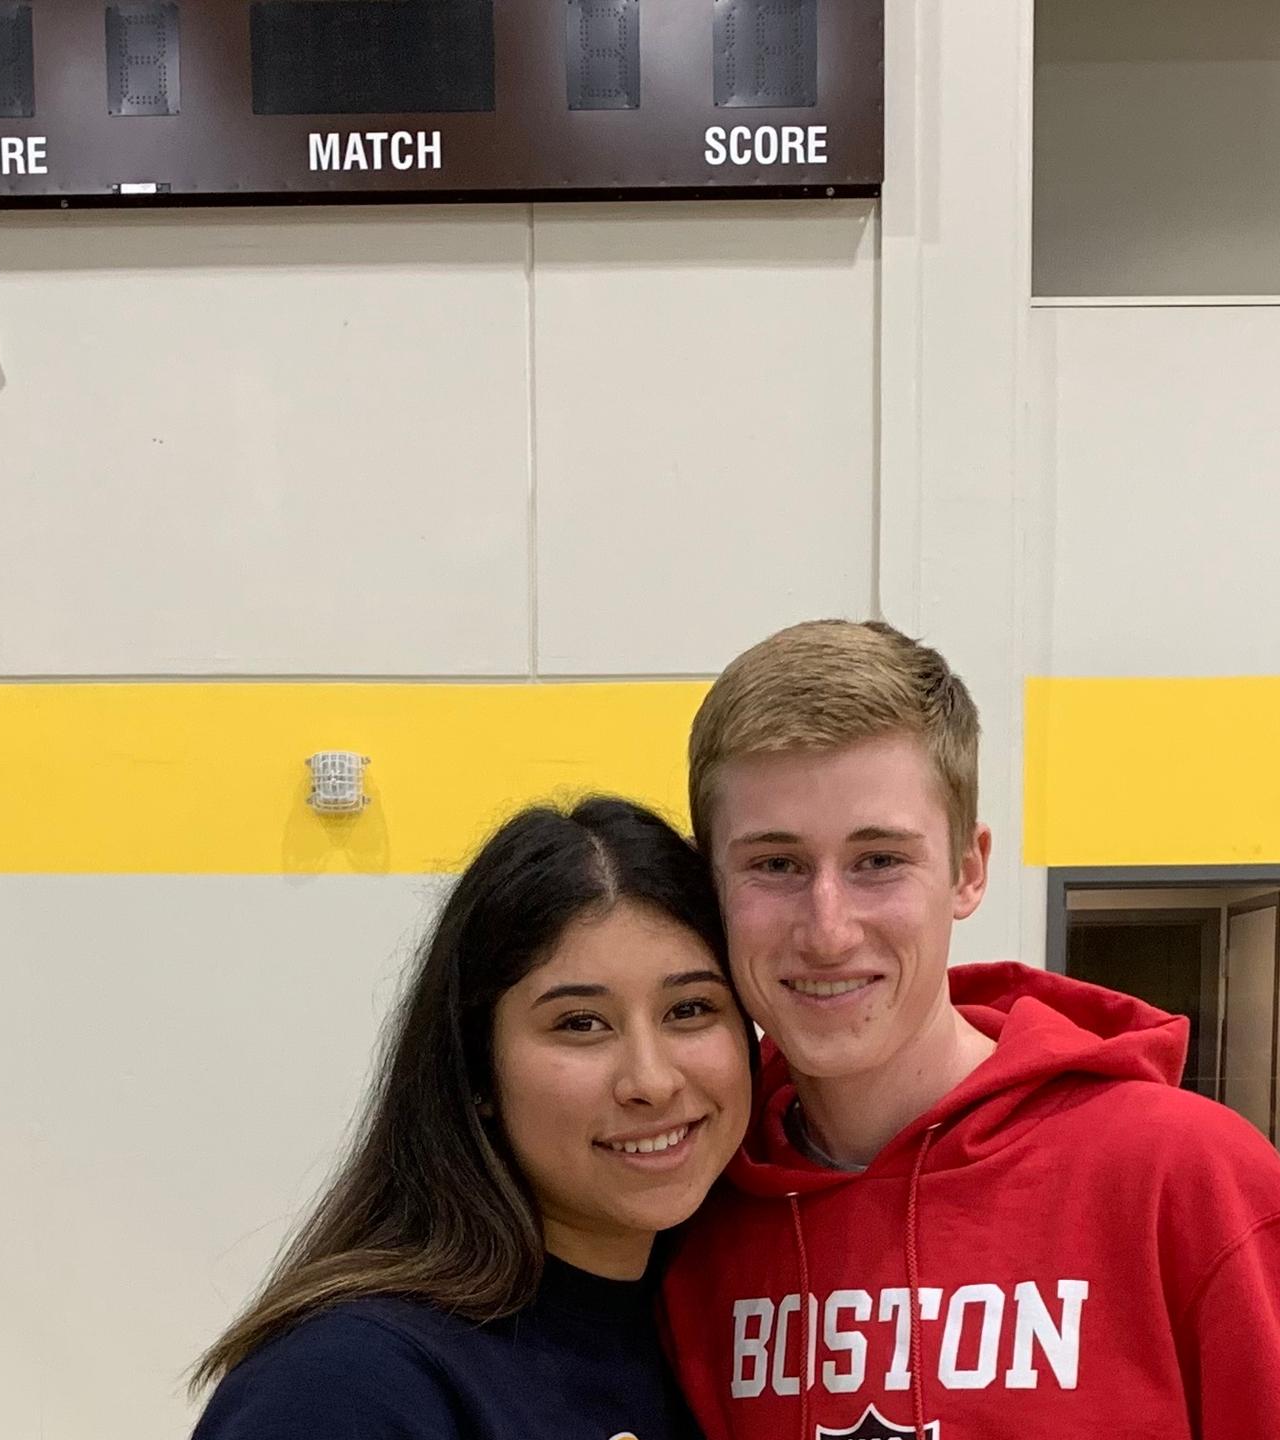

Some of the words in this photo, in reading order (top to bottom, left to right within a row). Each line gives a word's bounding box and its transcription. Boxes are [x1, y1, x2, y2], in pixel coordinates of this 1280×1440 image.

[308, 131, 444, 173] MATCH
[704, 124, 830, 167] SCORE
[730, 1279, 1091, 1400] BOSTON
